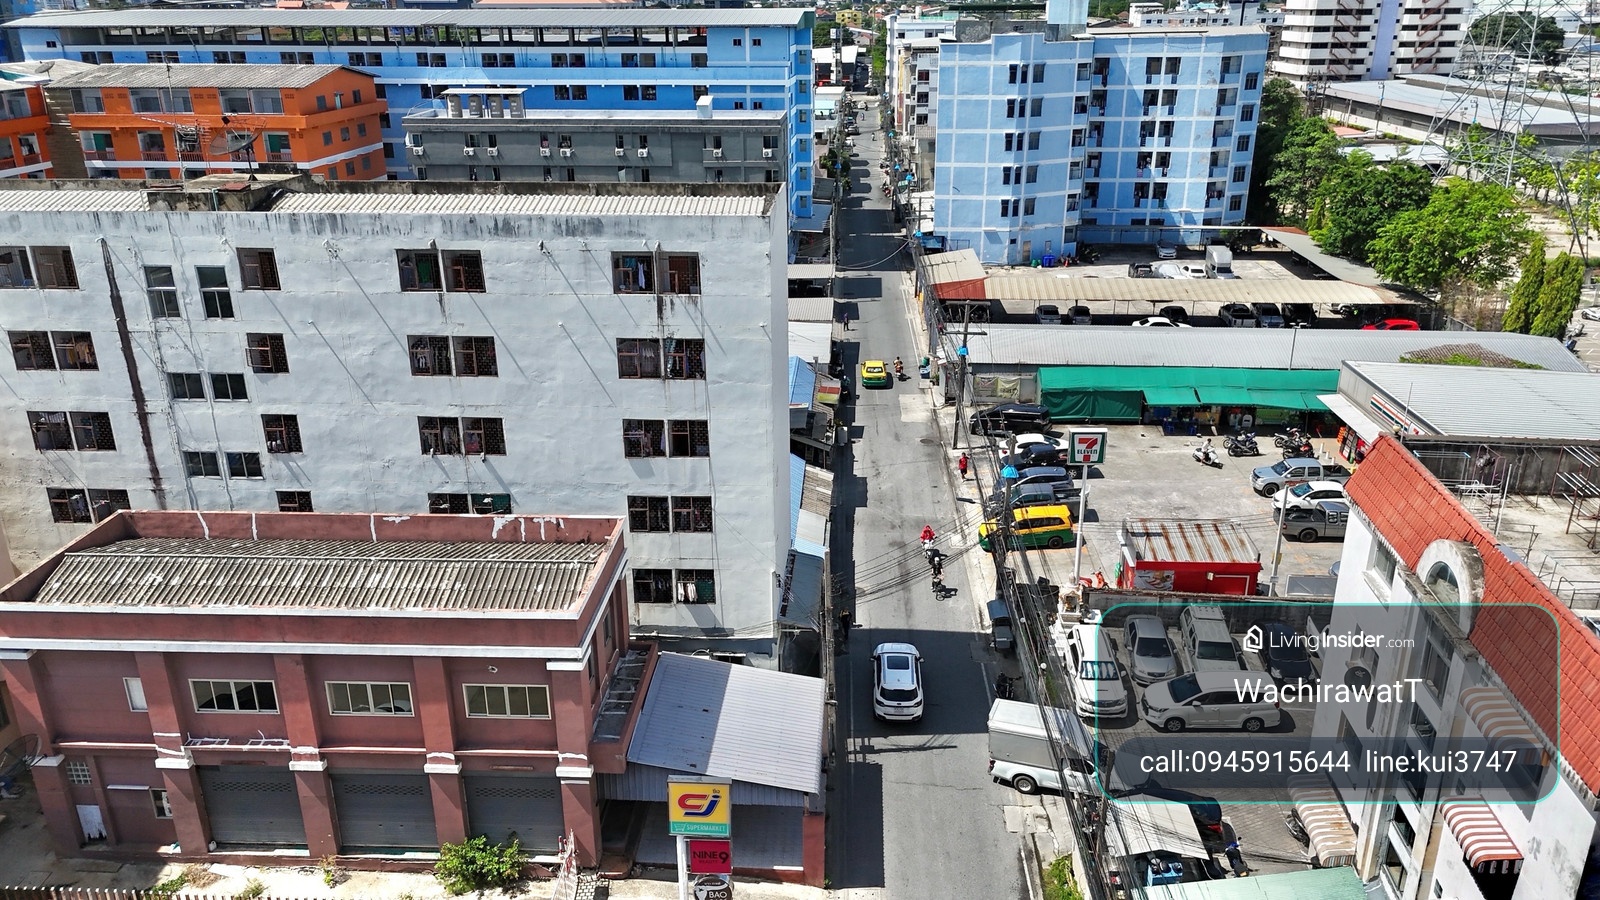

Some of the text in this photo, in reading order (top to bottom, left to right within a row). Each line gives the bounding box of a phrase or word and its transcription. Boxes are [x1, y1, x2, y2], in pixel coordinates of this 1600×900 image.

[686, 824, 725, 832] SUPERMARKET
[693, 851, 730, 864] NINE 9
[708, 891, 728, 899] BAO
